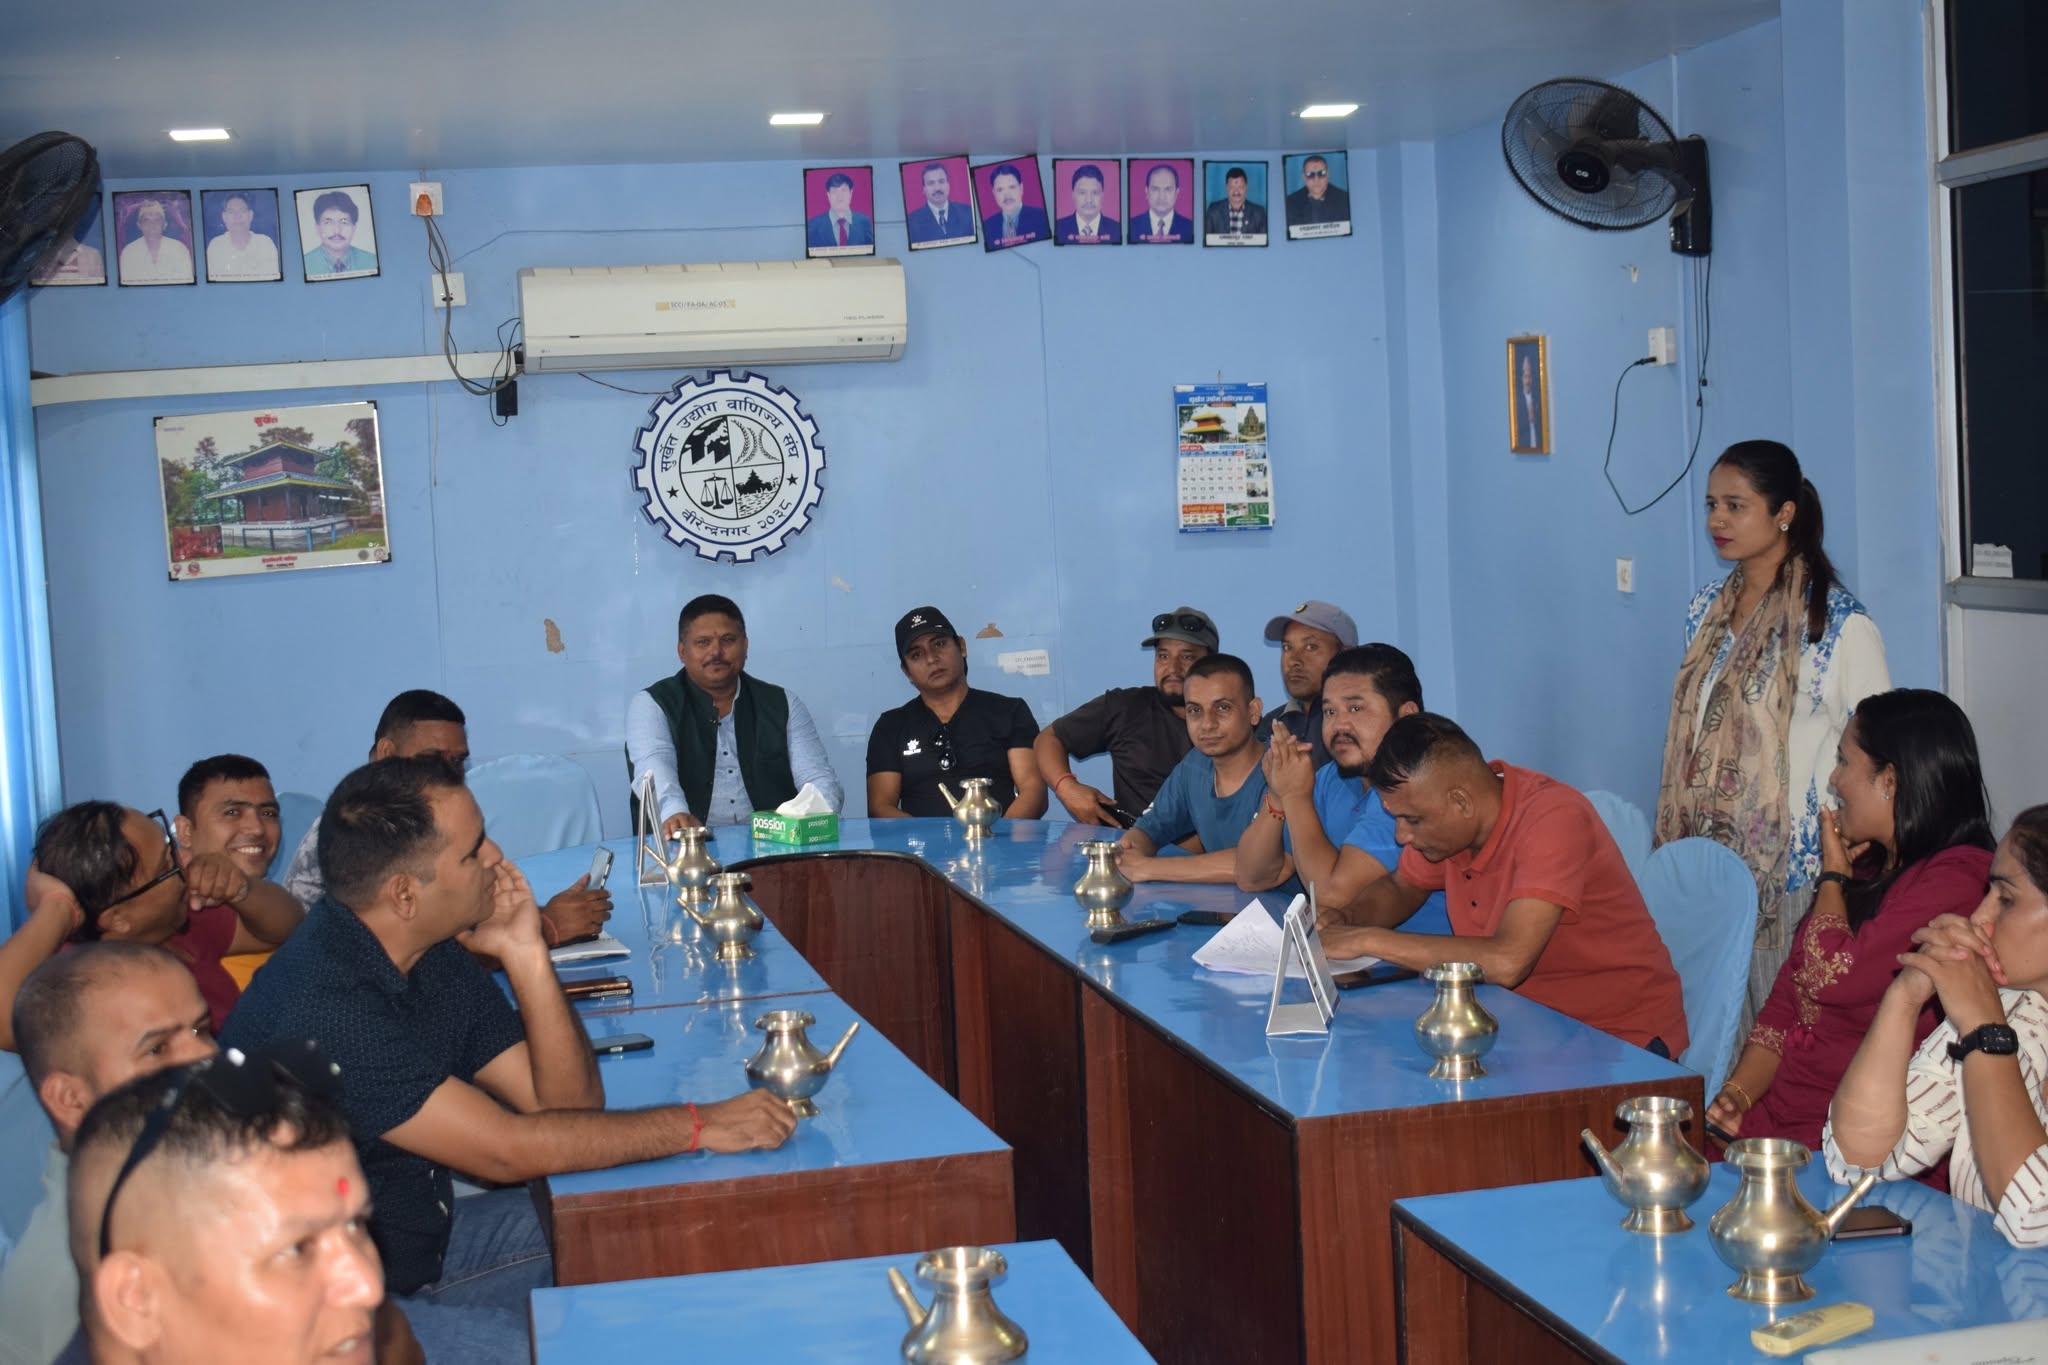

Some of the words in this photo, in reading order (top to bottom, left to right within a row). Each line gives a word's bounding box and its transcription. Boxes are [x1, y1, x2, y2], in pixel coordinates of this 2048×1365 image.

[659, 433, 679, 472] सुर्खेत
[676, 401, 718, 428] उद्योग
[726, 396, 784, 429] वाणिज्य
[782, 433, 800, 458] संघ
[682, 508, 751, 537] वीरेन्द्रनगर
[757, 498, 792, 529] २०३८
[753, 817, 786, 832] passion
